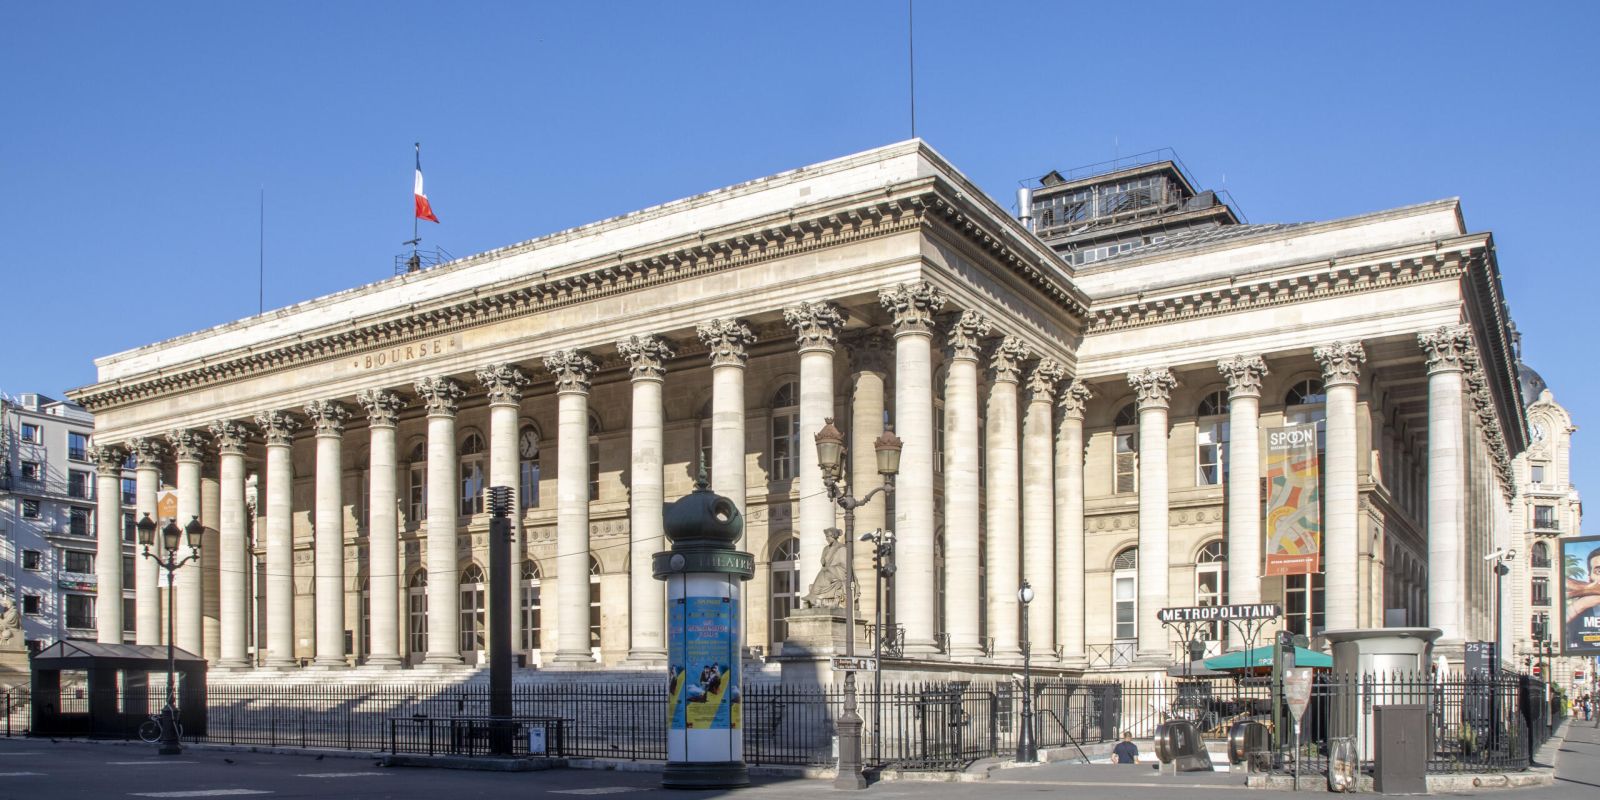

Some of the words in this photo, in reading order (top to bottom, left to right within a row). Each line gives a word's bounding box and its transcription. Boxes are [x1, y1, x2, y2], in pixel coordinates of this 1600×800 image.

[365, 340, 441, 369] BOURSE
[1270, 429, 1313, 446] SPOON
[1162, 605, 1274, 621] METROPOLITAIN
[1467, 644, 1479, 652] 25
